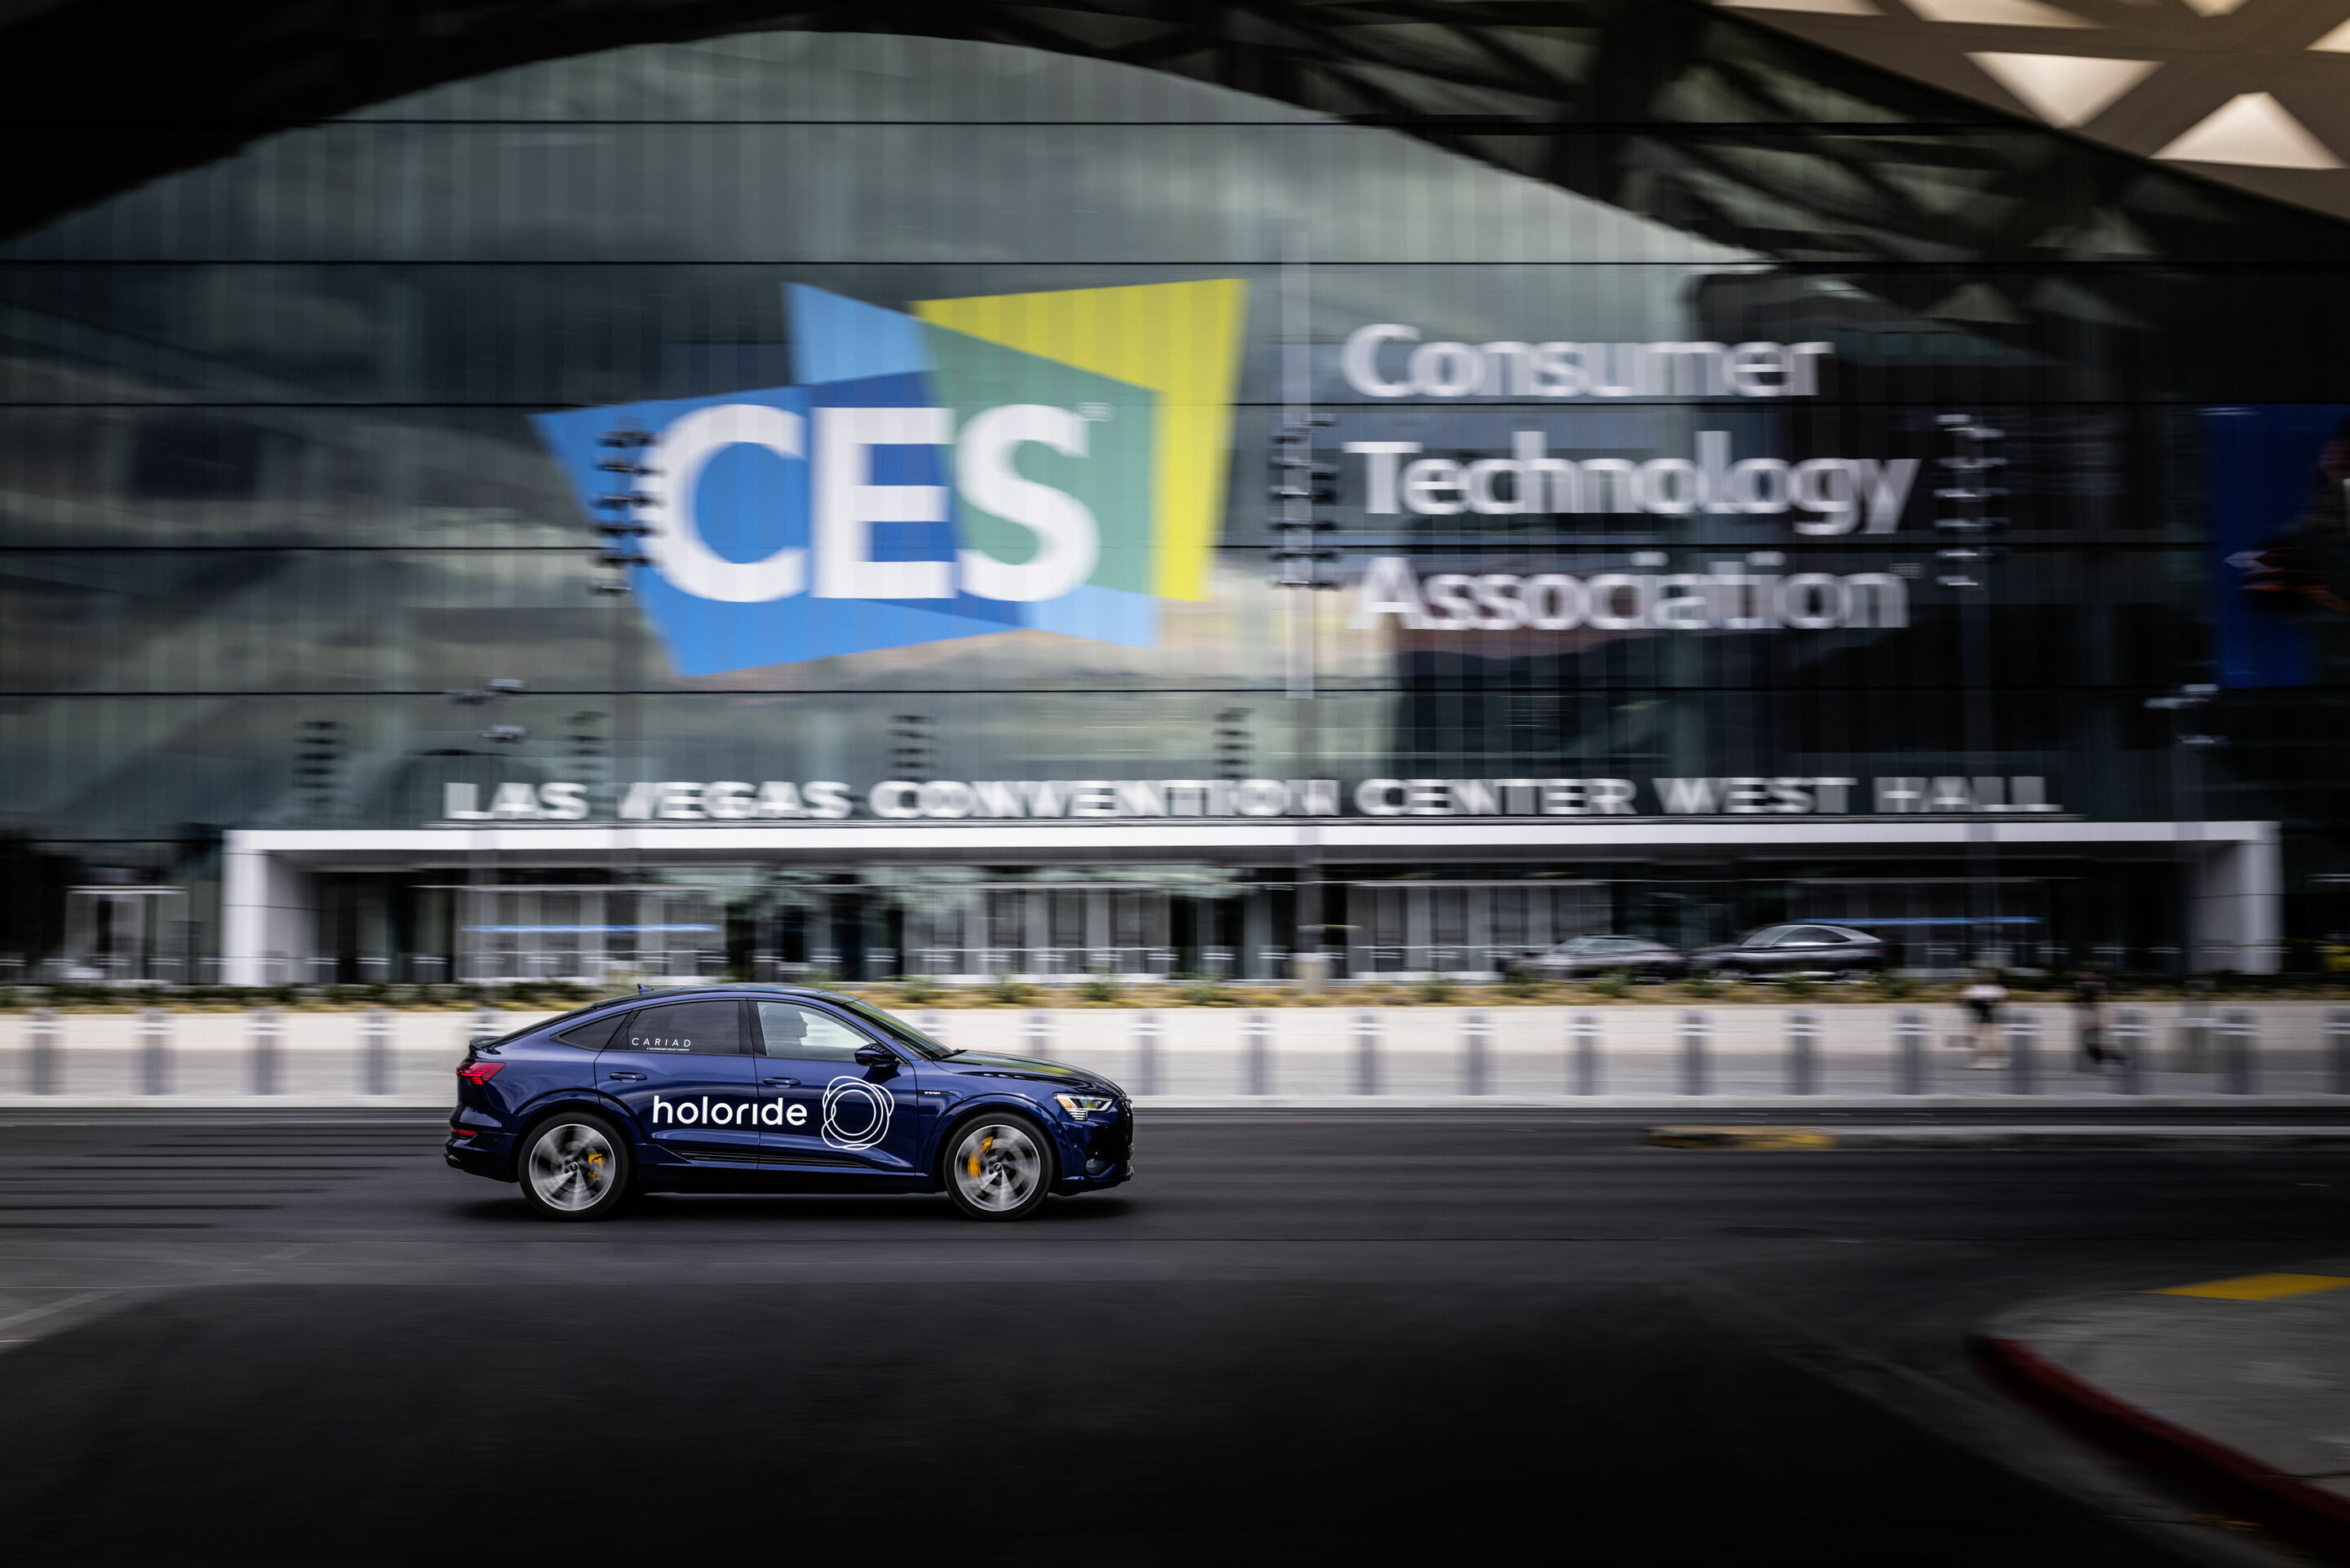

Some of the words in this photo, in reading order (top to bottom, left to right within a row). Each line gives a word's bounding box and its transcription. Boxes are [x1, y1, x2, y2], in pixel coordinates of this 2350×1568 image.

[1341, 323, 1834, 397] Consumer
[1342, 430, 1921, 535] Technology
[1350, 550, 1910, 630] Association
[444, 782, 589, 820] LAS
[869, 778, 1341, 818] CONVENTION
[1354, 777, 1638, 816] CENTER
[1652, 777, 1859, 814] WEST
[1873, 776, 2063, 813] HALL
[631, 1037, 691, 1048] CARIAD
[652, 1095, 808, 1126] holoride
